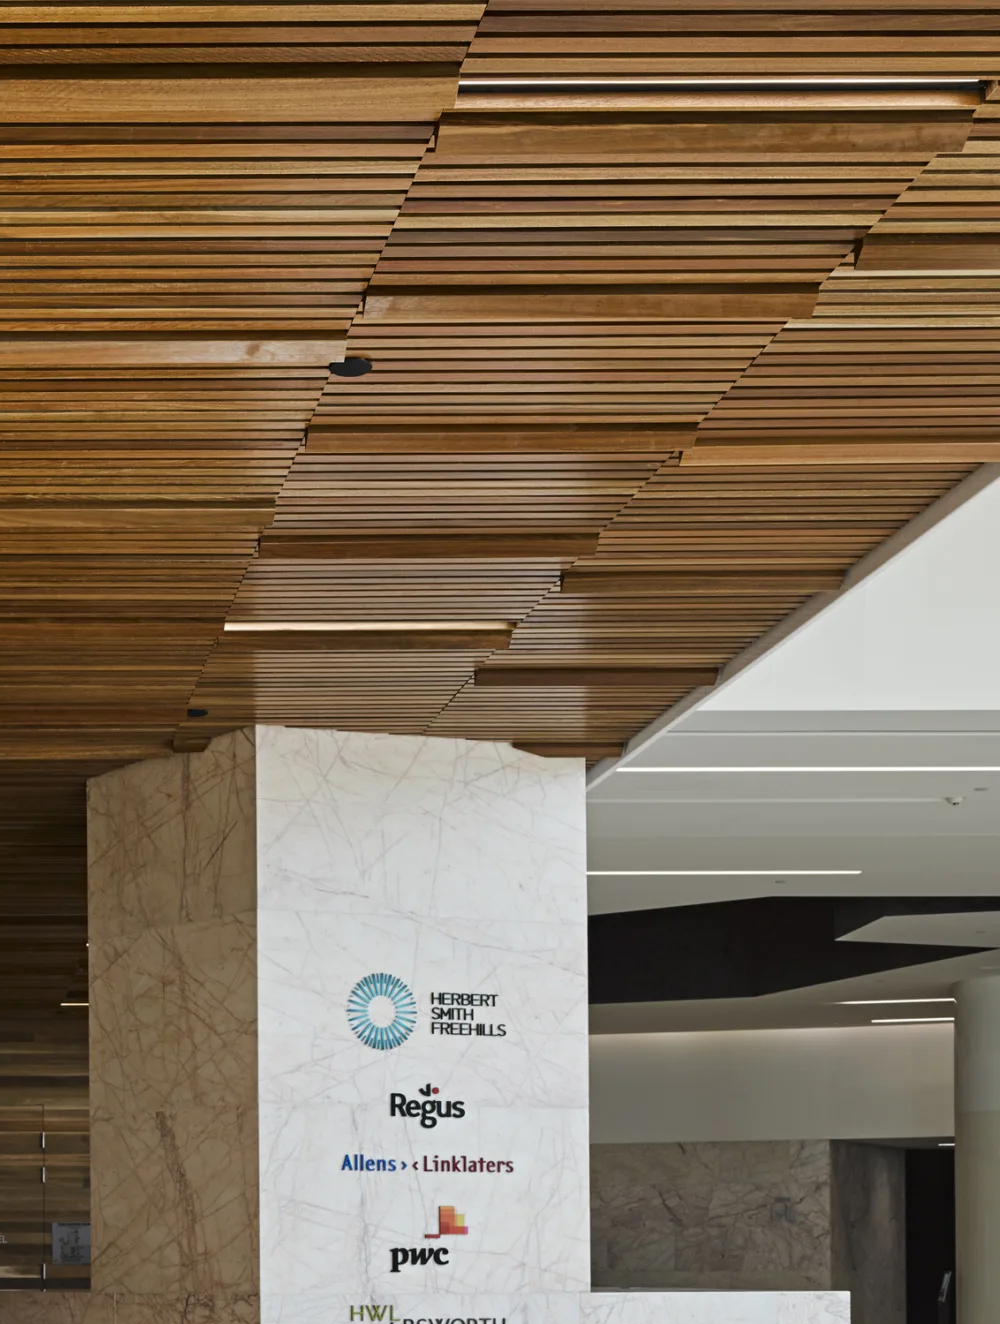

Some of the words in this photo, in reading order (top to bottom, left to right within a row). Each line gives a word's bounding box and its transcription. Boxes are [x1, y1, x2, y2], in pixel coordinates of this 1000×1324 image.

[431, 992, 499, 1007] HERBERT
[431, 1007, 474, 1021] SMITH
[431, 1022, 507, 1037] FREEHILLS
[390, 1093, 465, 1129] Regus
[341, 1154, 397, 1172] Allens
[423, 1155, 514, 1173] Linklaters
[390, 1246, 449, 1273] pwc
[350, 1305, 400, 1322] HWL
